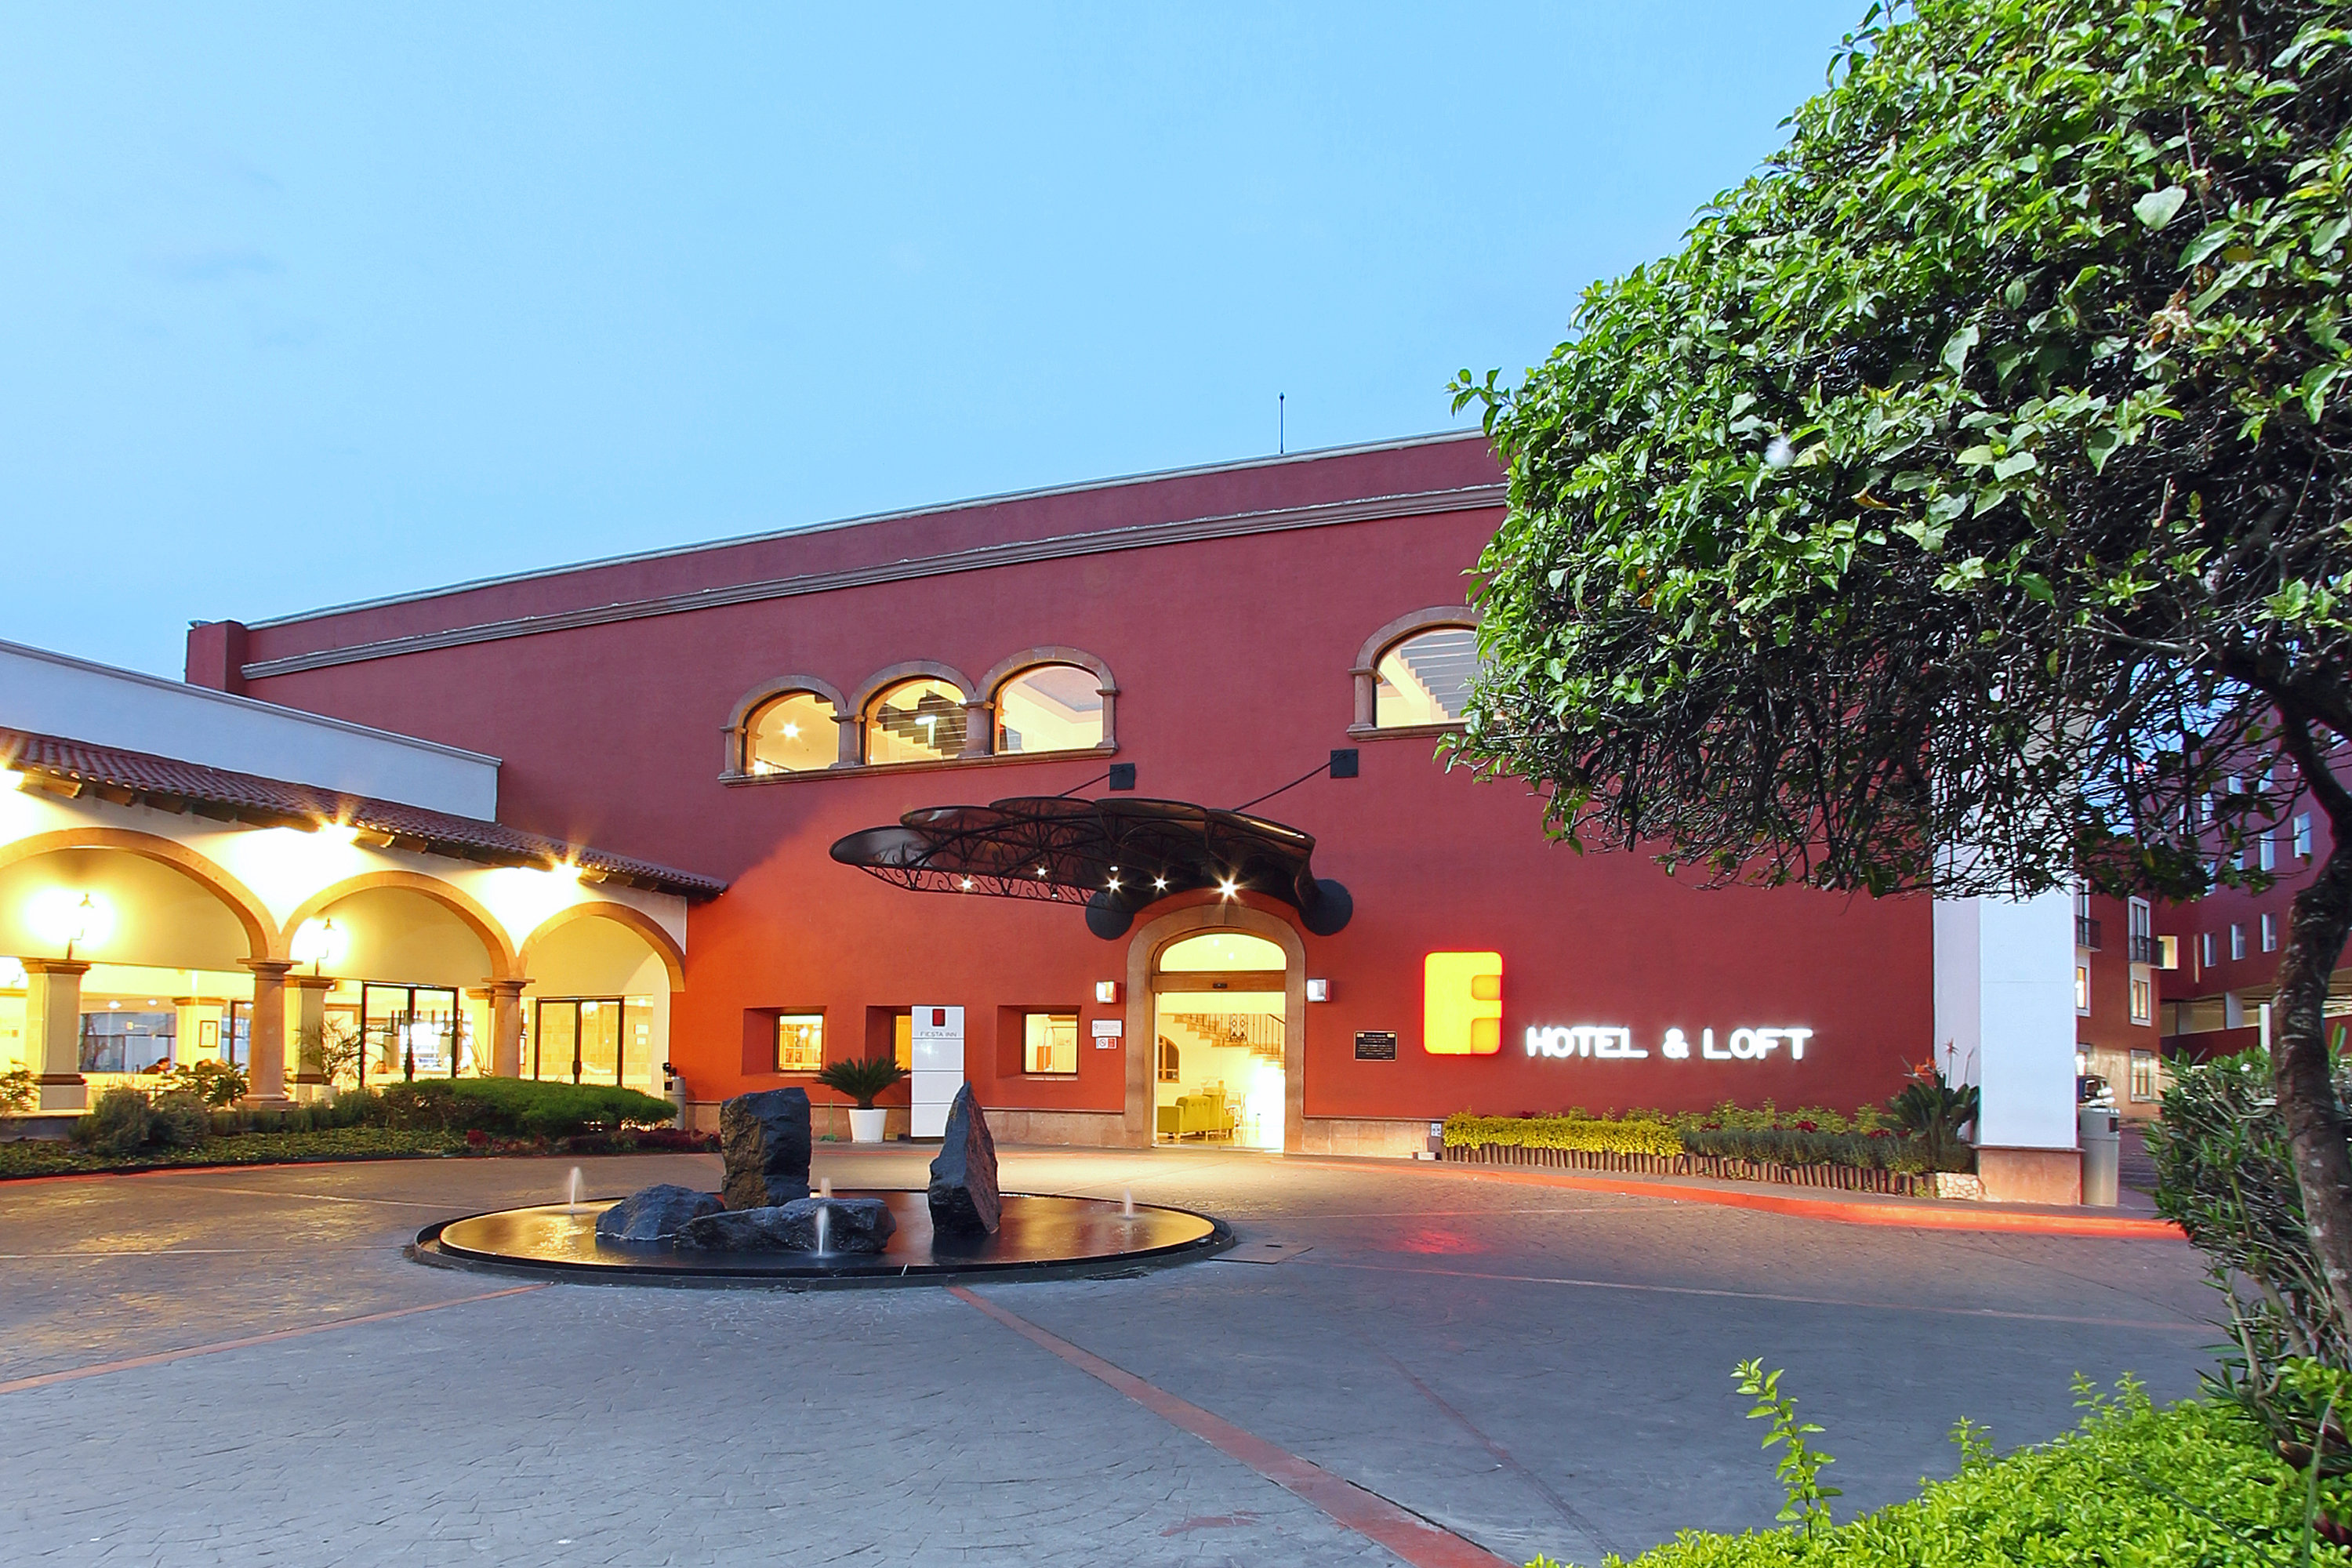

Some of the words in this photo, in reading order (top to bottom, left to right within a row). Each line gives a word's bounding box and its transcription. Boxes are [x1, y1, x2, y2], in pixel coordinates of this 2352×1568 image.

[1526, 1025, 1649, 1058] HOTEL
[1662, 1027, 1690, 1059] &
[1702, 1027, 1813, 1060] LOFT
